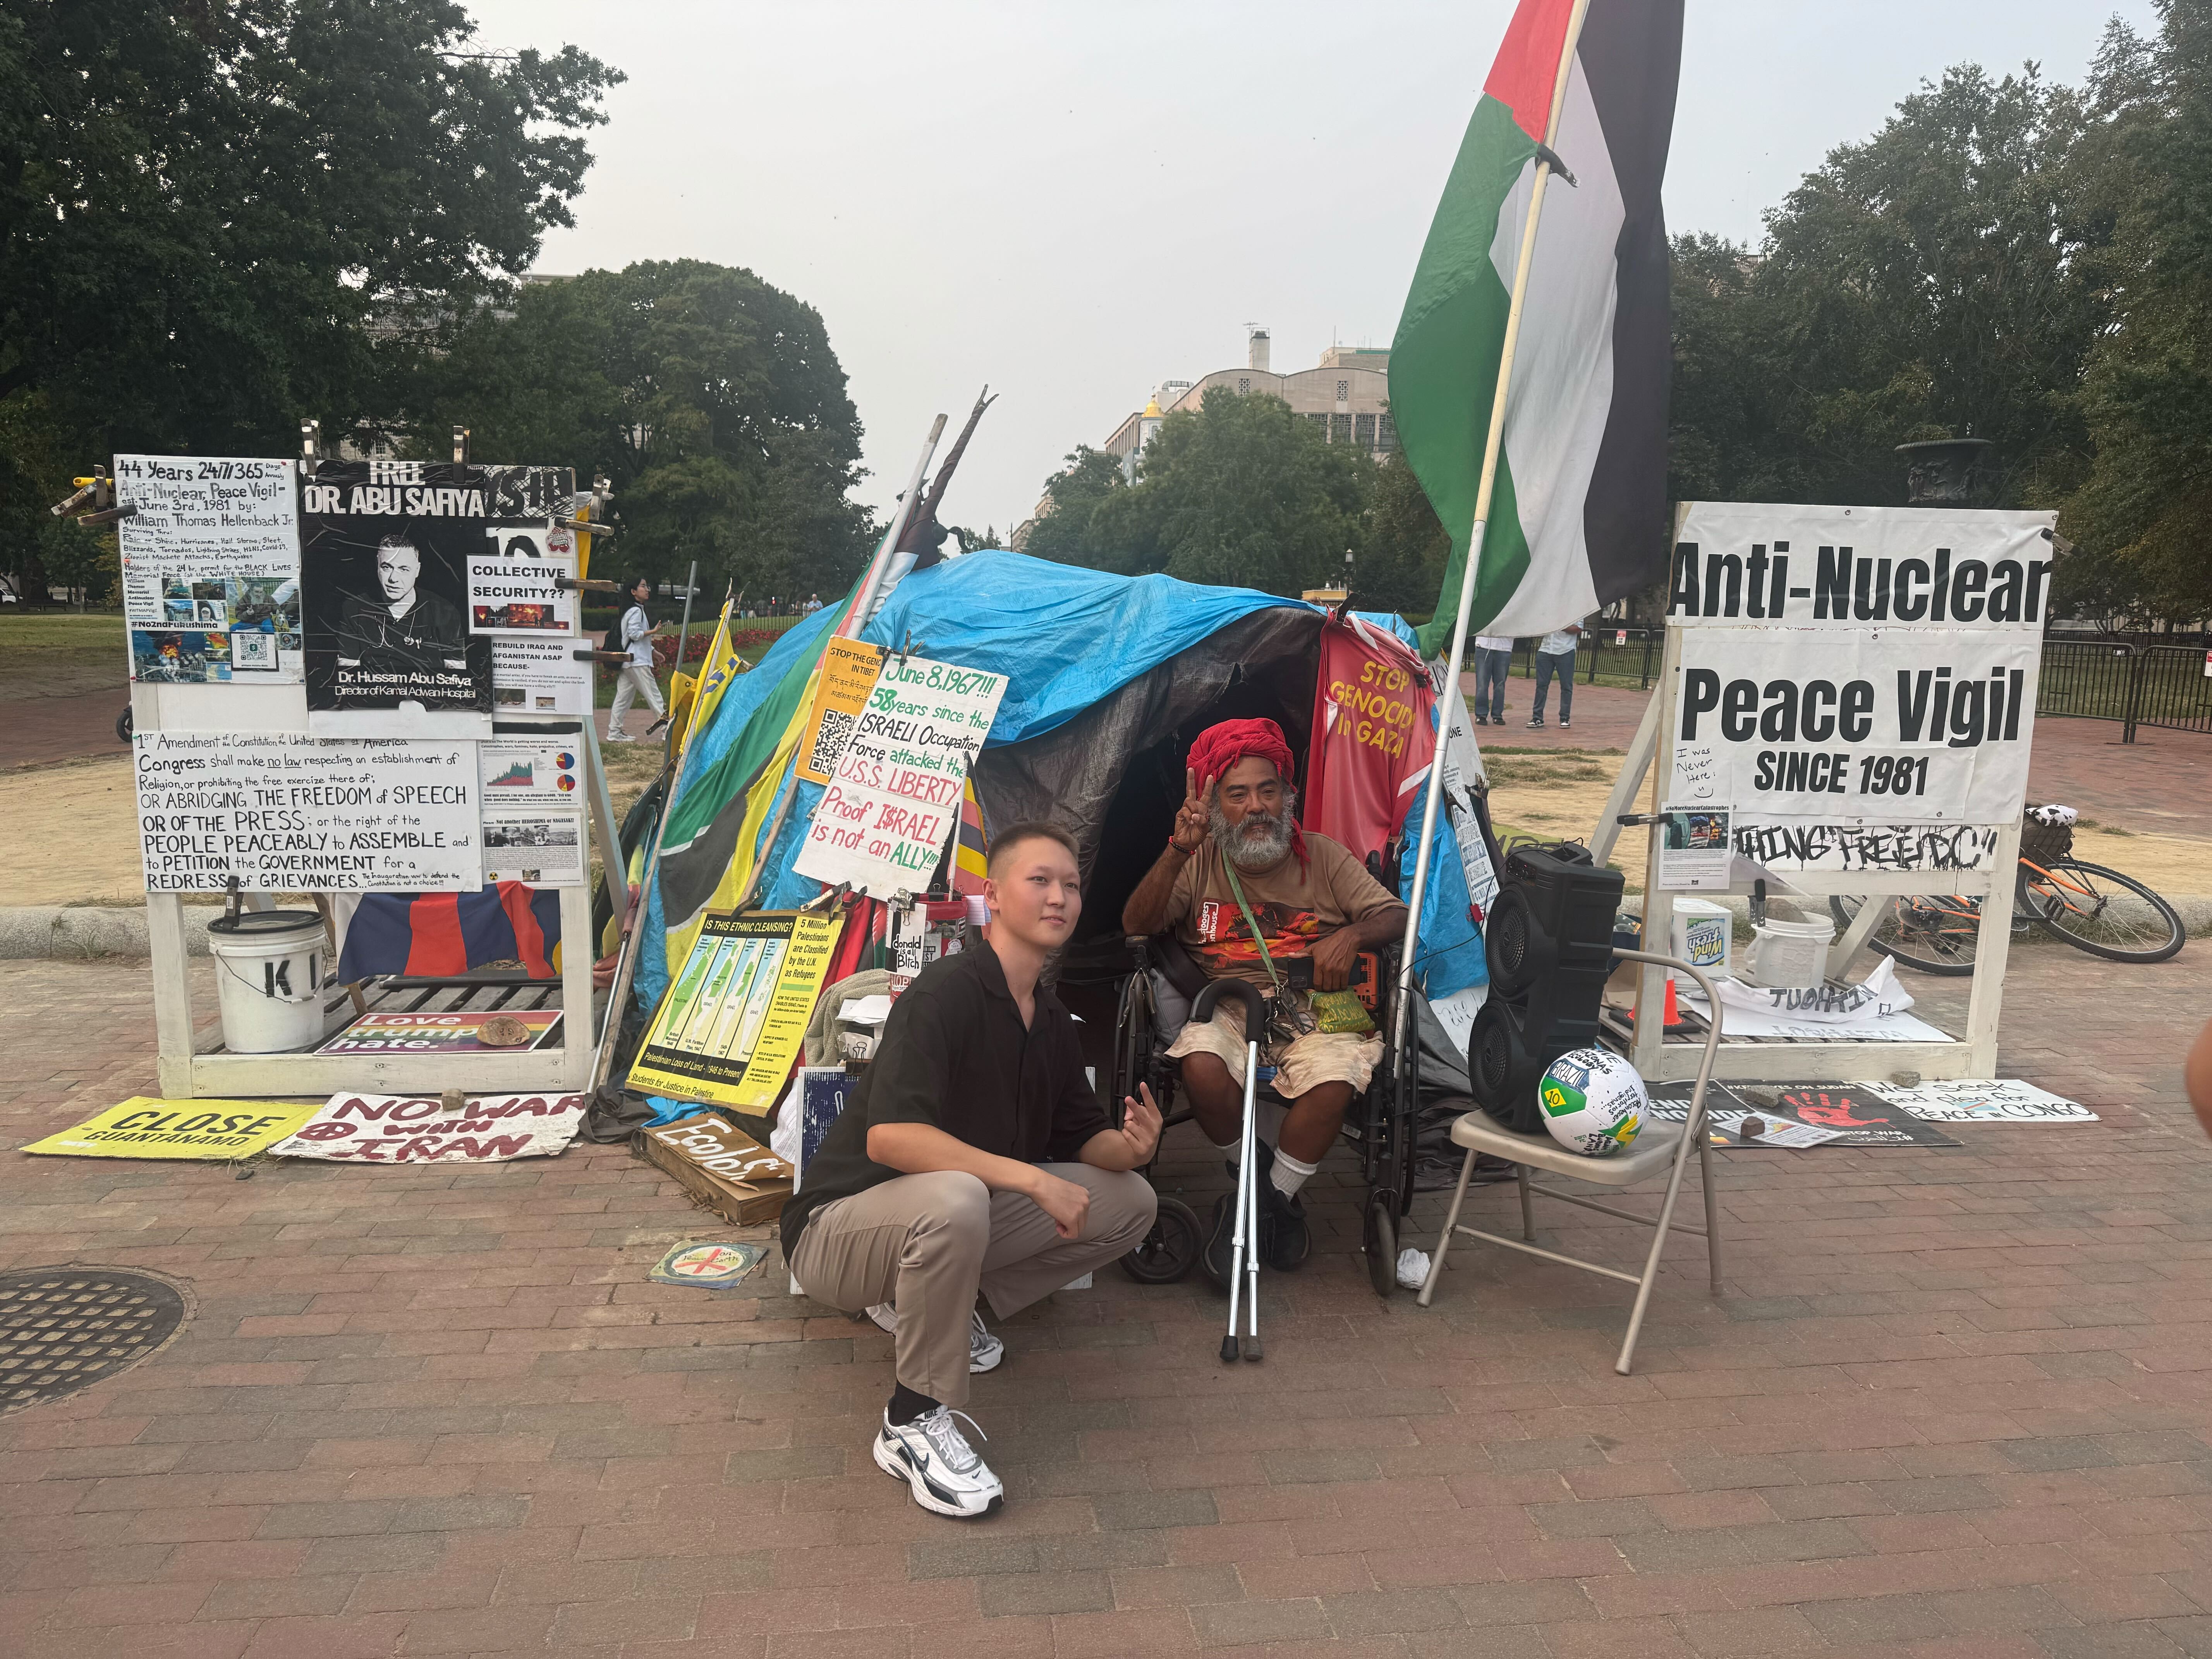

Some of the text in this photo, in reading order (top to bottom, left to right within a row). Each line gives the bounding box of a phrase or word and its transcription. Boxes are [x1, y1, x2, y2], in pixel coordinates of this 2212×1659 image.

[118, 460, 142, 477] 44
[148, 461, 193, 481] Years
[370, 461, 426, 486] FREE
[305, 485, 486, 518] DR. ABU SAFIYA
[123, 515, 168, 527] William
[172, 513, 216, 527] Thomas
[221, 514, 279, 527] Hellenback
[472, 565, 566, 578] COLLECTIVE
[1666, 541, 2052, 623] Anti-Nuclear
[473, 586, 565, 599] SECURITY??
[131, 621, 218, 629] #No2ndFukushima
[830, 647, 866, 663] STOP THE
[338, 671, 472, 687] Dr. Hussam Abu Safiya
[851, 664, 875, 677] IN TIBET
[885, 658, 925, 685] June
[1360, 660, 1410, 693] STOP
[335, 685, 476, 699] Director of Kamal Adwan Hospital
[1681, 666, 2024, 748] Peace Vigil
[931, 704, 965, 723] since
[969, 709, 990, 730] the
[857, 712, 980, 752] ISRAELI Occupation
[1357, 720, 1404, 759] GAZA
[847, 734, 964, 778] Force attacked the
[1676, 747, 1710, 758] I was
[139, 754, 206, 775] Congress
[210, 753, 233, 768] shall
[237, 755, 265, 767] make
[267, 758, 282, 768] no
[284, 753, 302, 768] law
[304, 754, 353, 768] respecting
[372, 752, 442, 765] establishment
[446, 752, 460, 765] of
[1677, 759, 1713, 774] Never
[1753, 750, 1930, 796] SINCE 1981
[887, 768, 962, 806] LIBERTY
[141, 793, 160, 809] OR
[165, 792, 247, 809] ABRIDGING
[253, 789, 286, 807] THE
[291, 786, 371, 807] FREEDOM
[376, 788, 388, 804] of
[393, 785, 466, 805] SPEECH
[820, 785, 873, 823] Proof
[144, 831, 469, 854] PEOPLE PEACEABLY to ASSEMBLE and
[811, 819, 830, 842] is
[831, 827, 866, 850] not
[868, 838, 891, 860] an
[147, 873, 228, 890] REDRESS
[239, 875, 253, 888] of
[705, 920, 793, 933] IS THIS ETHNIC CLEANSING?
[801, 919, 827, 930] 5 Million
[797, 931, 830, 942] Palestinians
[893, 934, 922, 950] donald
[804, 945, 829, 955] Classified
[1692, 938, 1723, 963] Wind
[789, 956, 817, 967] by the U.N.
[793, 969, 816, 980] Refugees
[360, 1015, 462, 1026] Love
[347, 1025, 479, 1040] trump
[644, 1052, 672, 1065] Palestinian
[671, 1057, 684, 1068] Loss
[684, 1061, 690, 1069] of
[689, 1062, 703, 1072] Land
[723, 1068, 742, 1079] Present
[631, 1073, 655, 1086] Students
[654, 1078, 663, 1087] for
[663, 1081, 685, 1092] Justice
[1549, 1061, 1587, 1088] BRAZIL
[1932, 1080, 2022, 1093] seek
[1547, 1091, 1560, 1105] 10
[1887, 1092, 2030, 1106] and plea for
[331, 1097, 443, 1121] NO
[1902, 1106, 1984, 1121] PEACE
[2000, 1103, 2093, 1118] CONGO
[110, 1111, 287, 1135] CLOSE
[383, 1120, 495, 1135] WITH
[83, 1130, 250, 1147] GUANTÁNAMO
[328, 1133, 534, 1161] IRAN
[924, 1408, 938, 1420] NIKE
